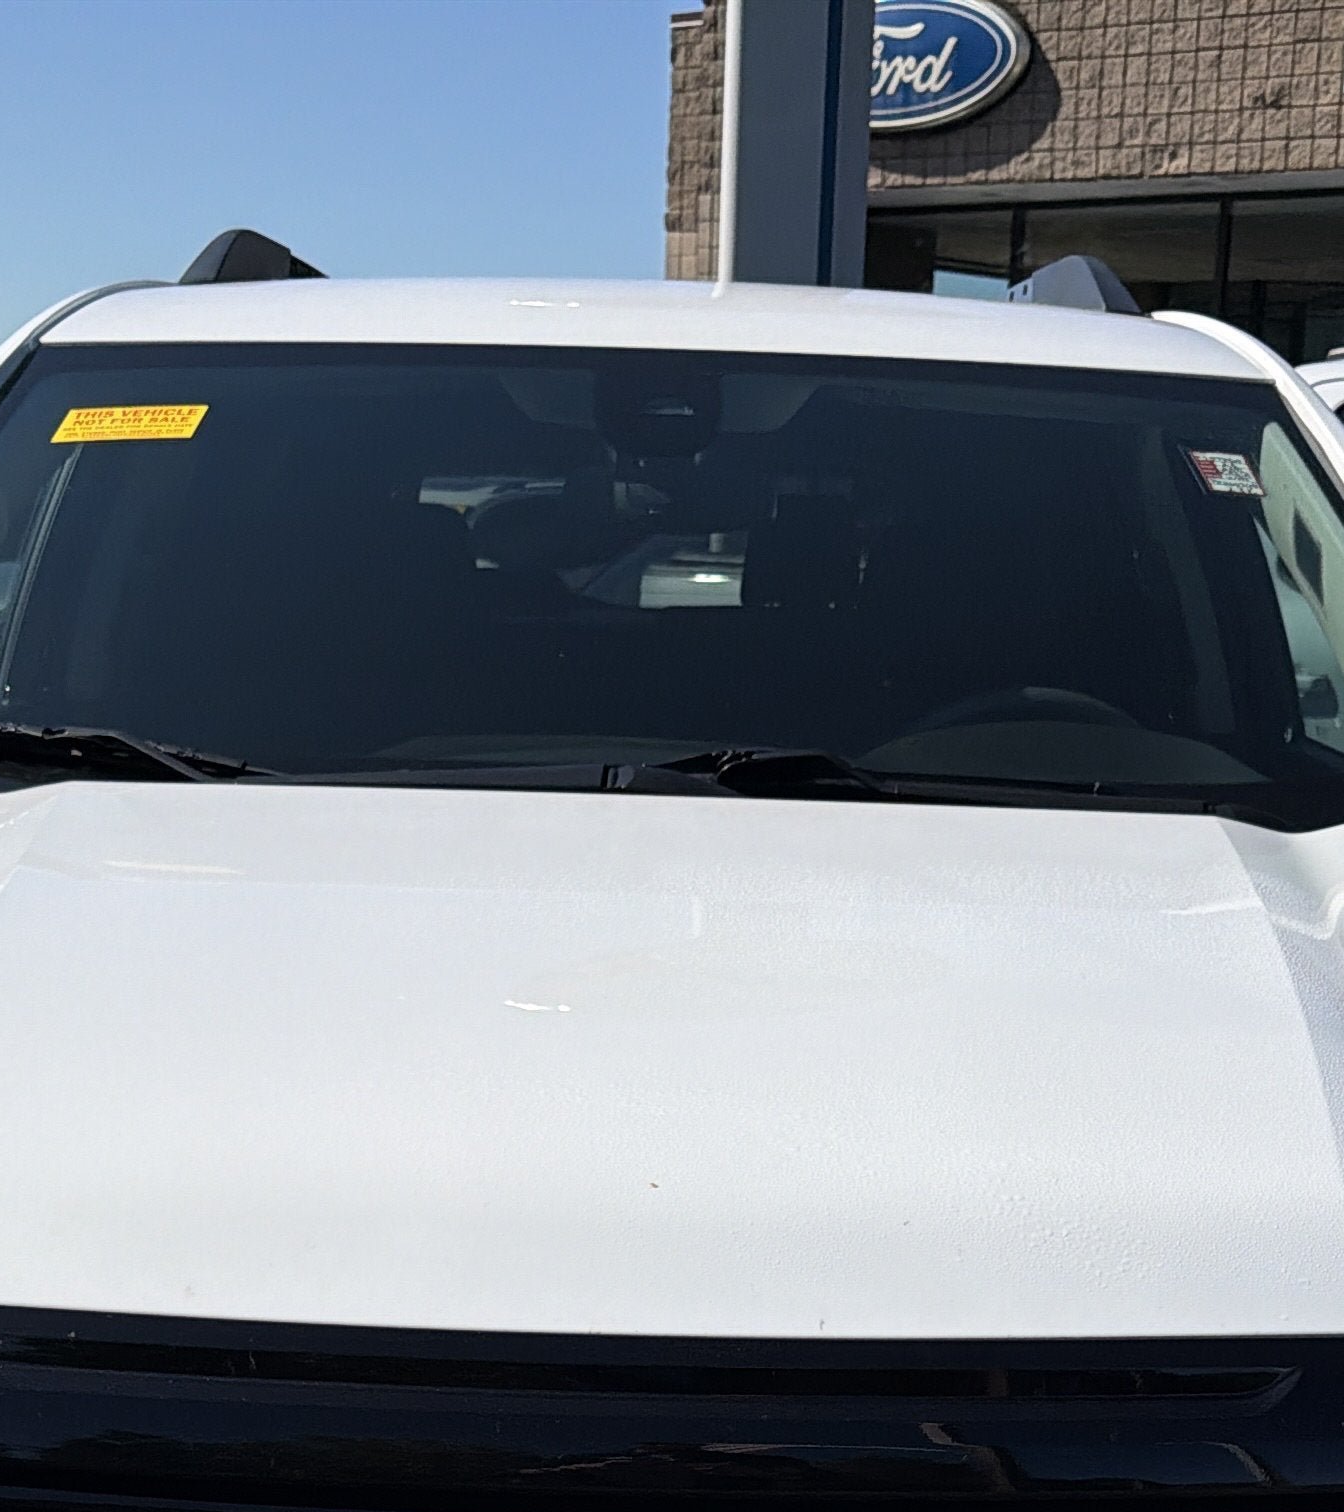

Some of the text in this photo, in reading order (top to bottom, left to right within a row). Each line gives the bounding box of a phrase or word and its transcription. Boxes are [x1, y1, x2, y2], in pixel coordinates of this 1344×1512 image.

[73, 408, 200, 420] THIS VEHICLE
[72, 416, 190, 427] NOT FOR SALE
